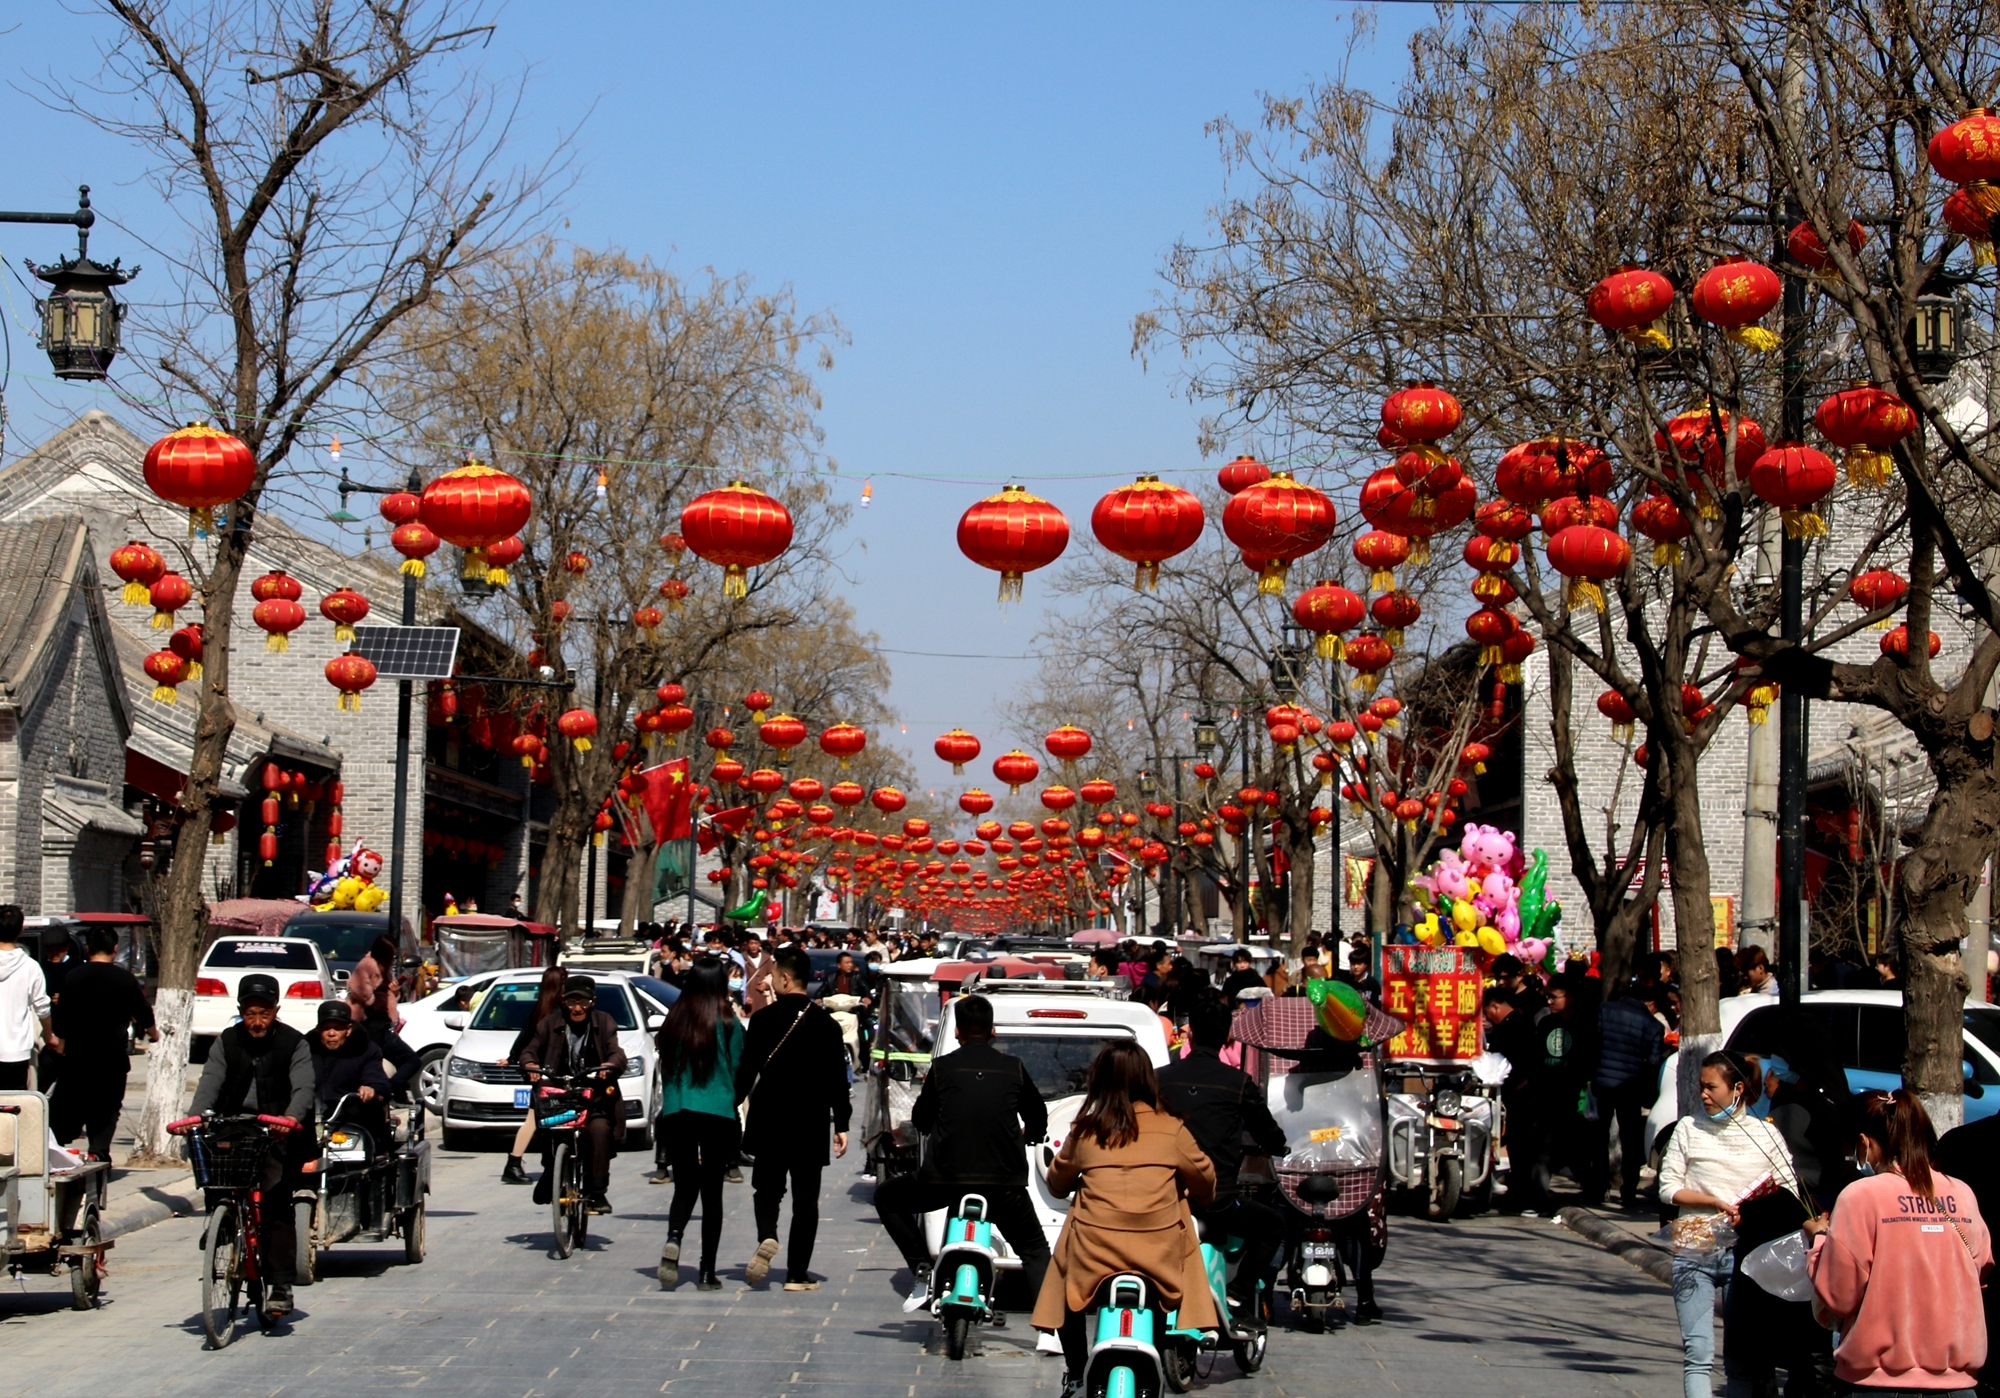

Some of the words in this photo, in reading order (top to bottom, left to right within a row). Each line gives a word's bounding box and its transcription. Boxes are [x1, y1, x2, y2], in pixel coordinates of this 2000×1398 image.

[1458, 949, 1476, 975] 真
[1389, 979, 1477, 1016] 五香羊脑
[1897, 1195, 1957, 1214] STRONG
